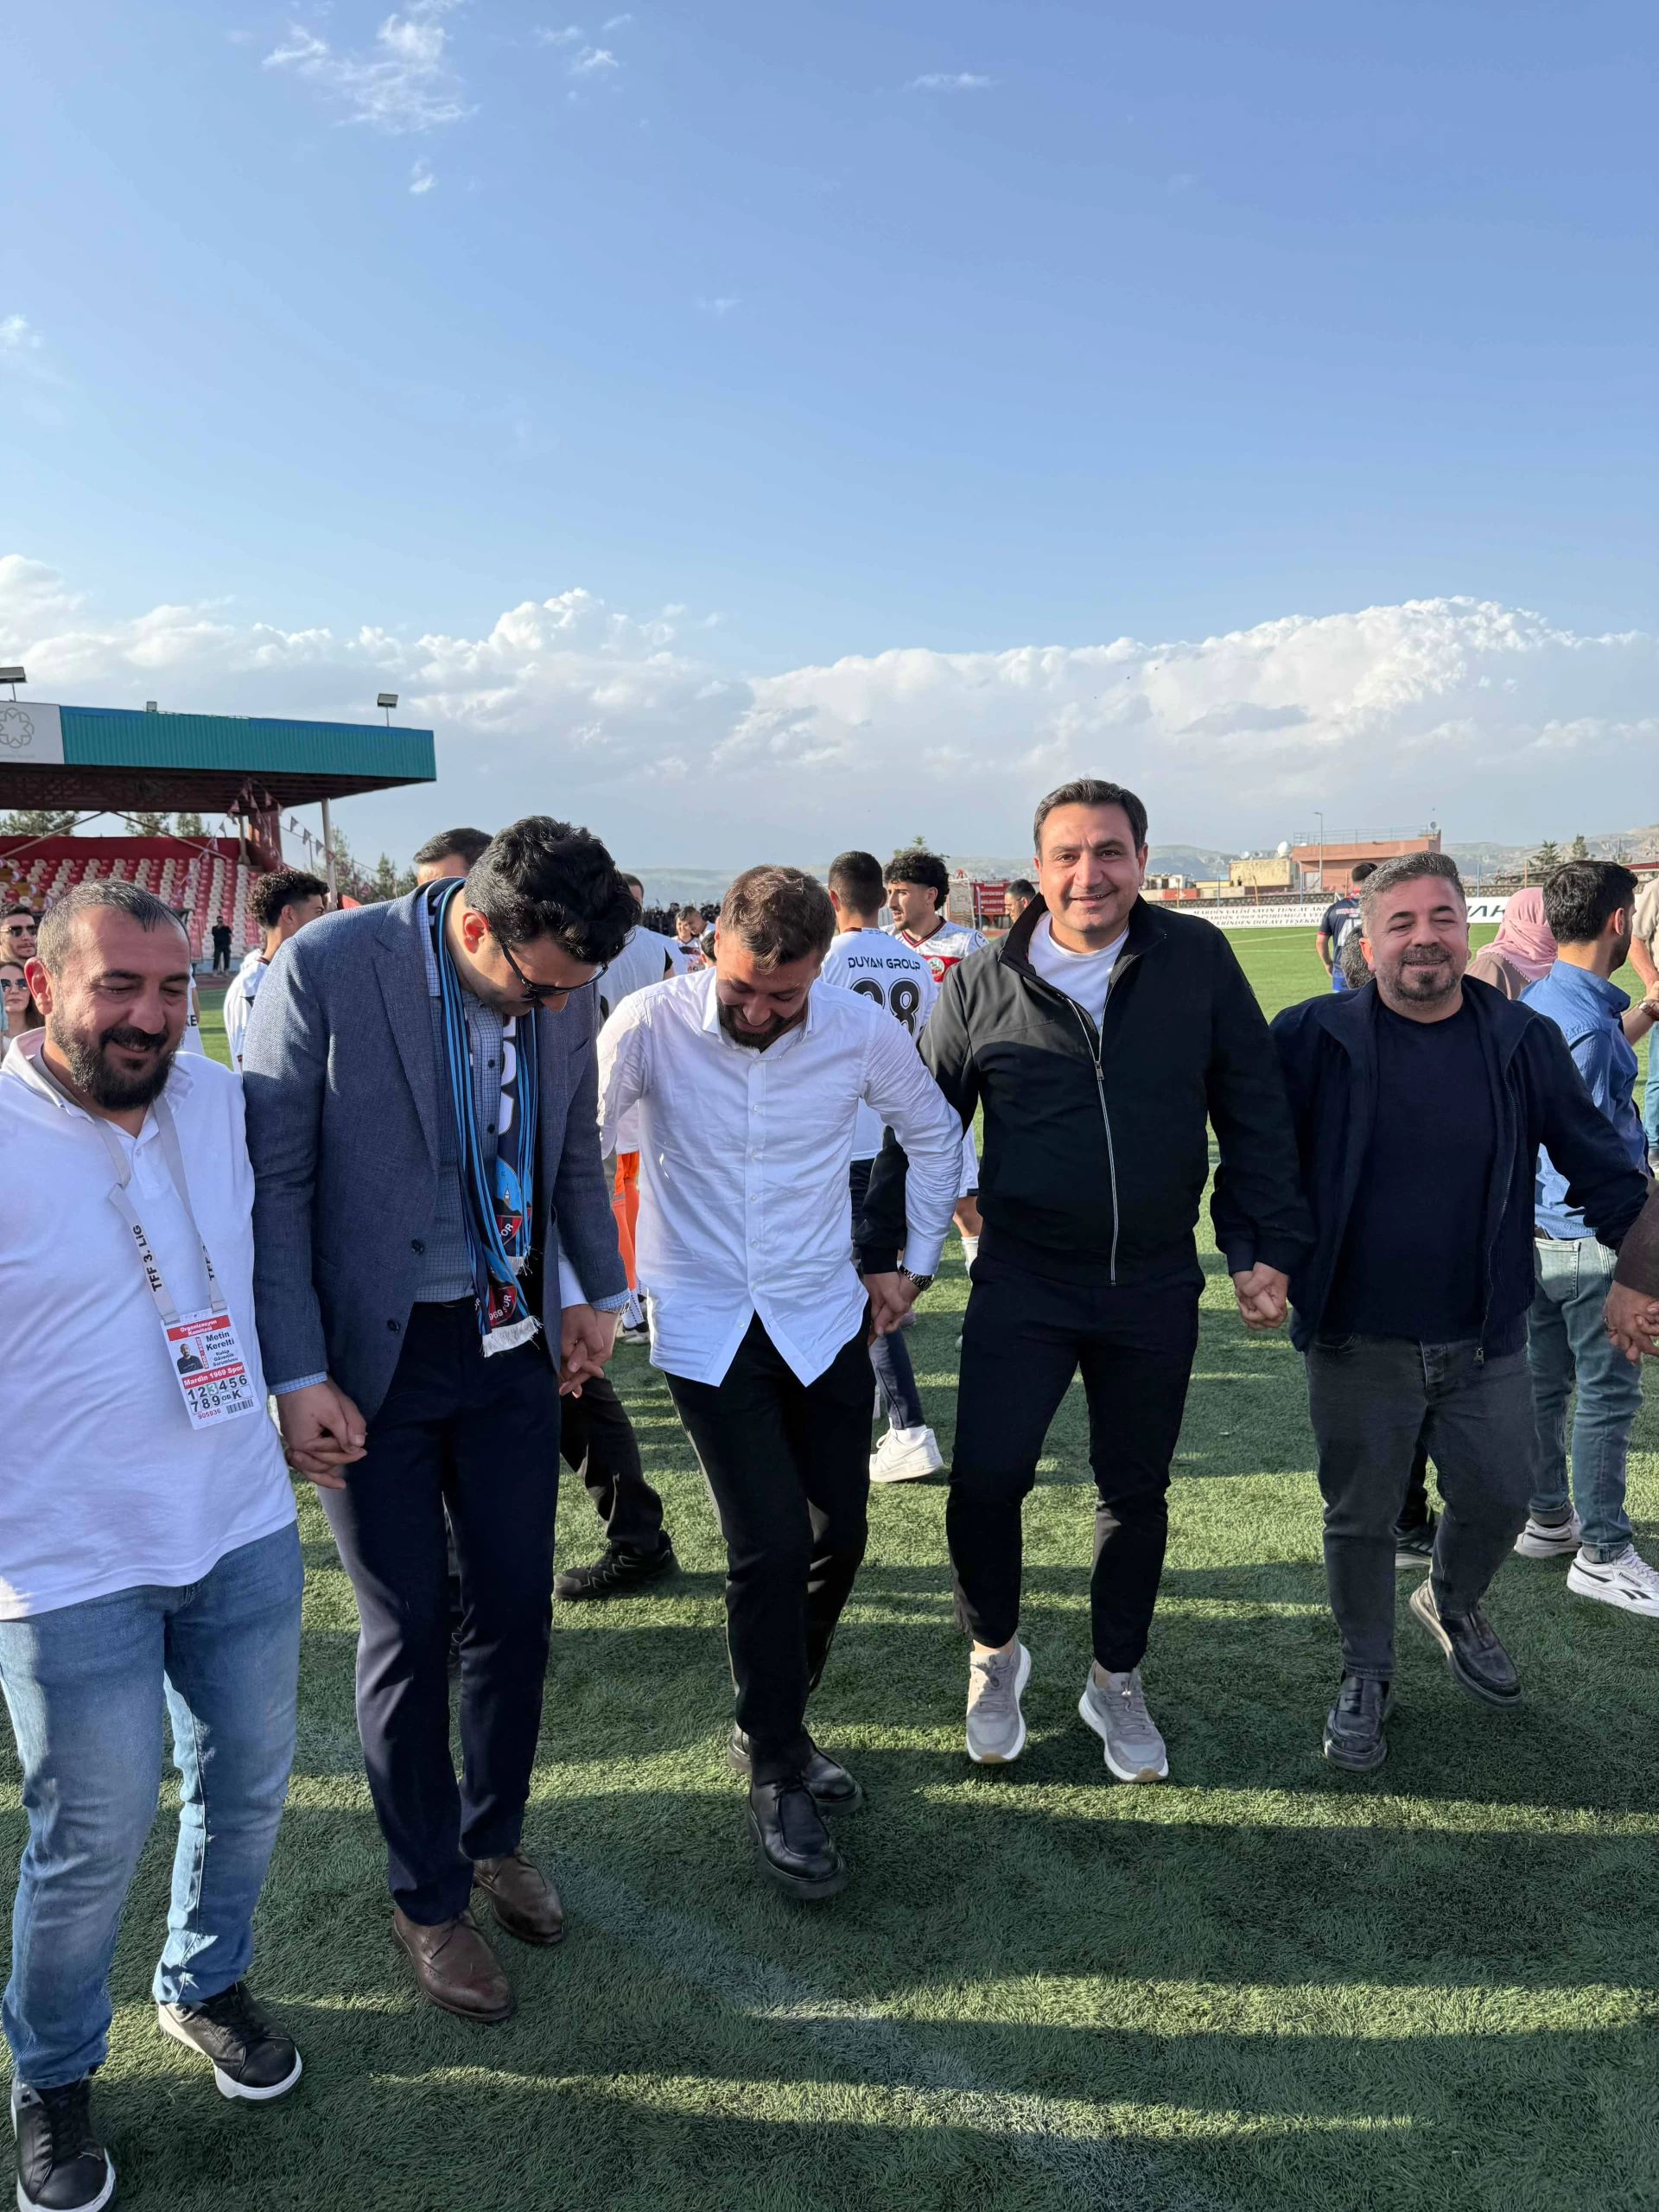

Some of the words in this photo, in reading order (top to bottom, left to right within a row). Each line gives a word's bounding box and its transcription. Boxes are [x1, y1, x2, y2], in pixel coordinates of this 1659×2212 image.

[848, 956, 884, 969] DUYAN
[886, 957, 921, 971] GROUP
[500, 1223, 514, 1237] OR
[143, 1249, 153, 1263] 3.
[146, 1267, 162, 1292] TFF
[206, 1332, 230, 1343] Metin
[206, 1338, 235, 1351] Kerelti
[183, 1375, 208, 1386] Mardin
[209, 1370, 226, 1378] 1969
[227, 1365, 244, 1375] Spor
